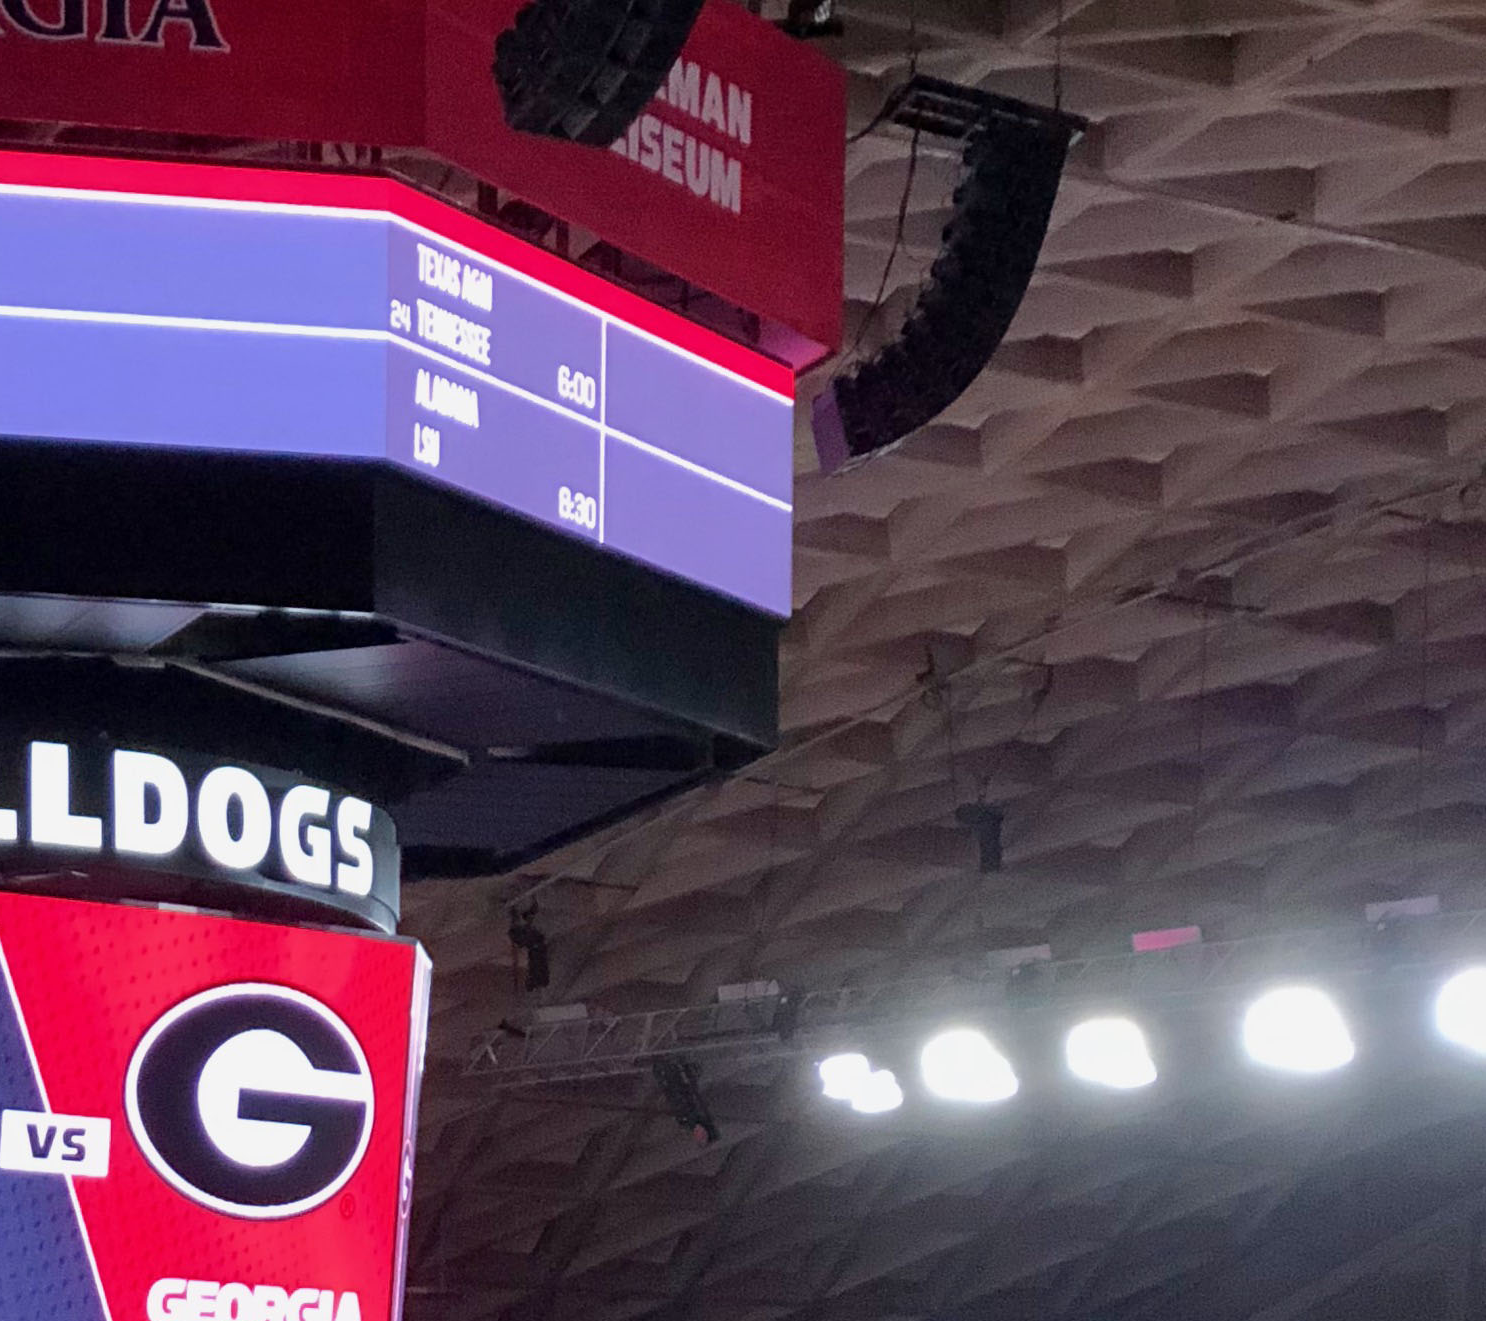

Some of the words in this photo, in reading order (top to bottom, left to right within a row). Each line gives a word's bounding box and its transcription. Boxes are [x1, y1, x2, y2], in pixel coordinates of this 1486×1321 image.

[610, 114, 742, 214] ISEUM
[417, 243, 461, 298] TEXAS
[390, 300, 411, 333] 24
[417, 299, 491, 365] TENNESSEE
[558, 365, 595, 409] 6:00
[414, 422, 440, 467] LSU
[558, 486, 596, 529] 8:30
[26, 1124, 87, 1163] VS
